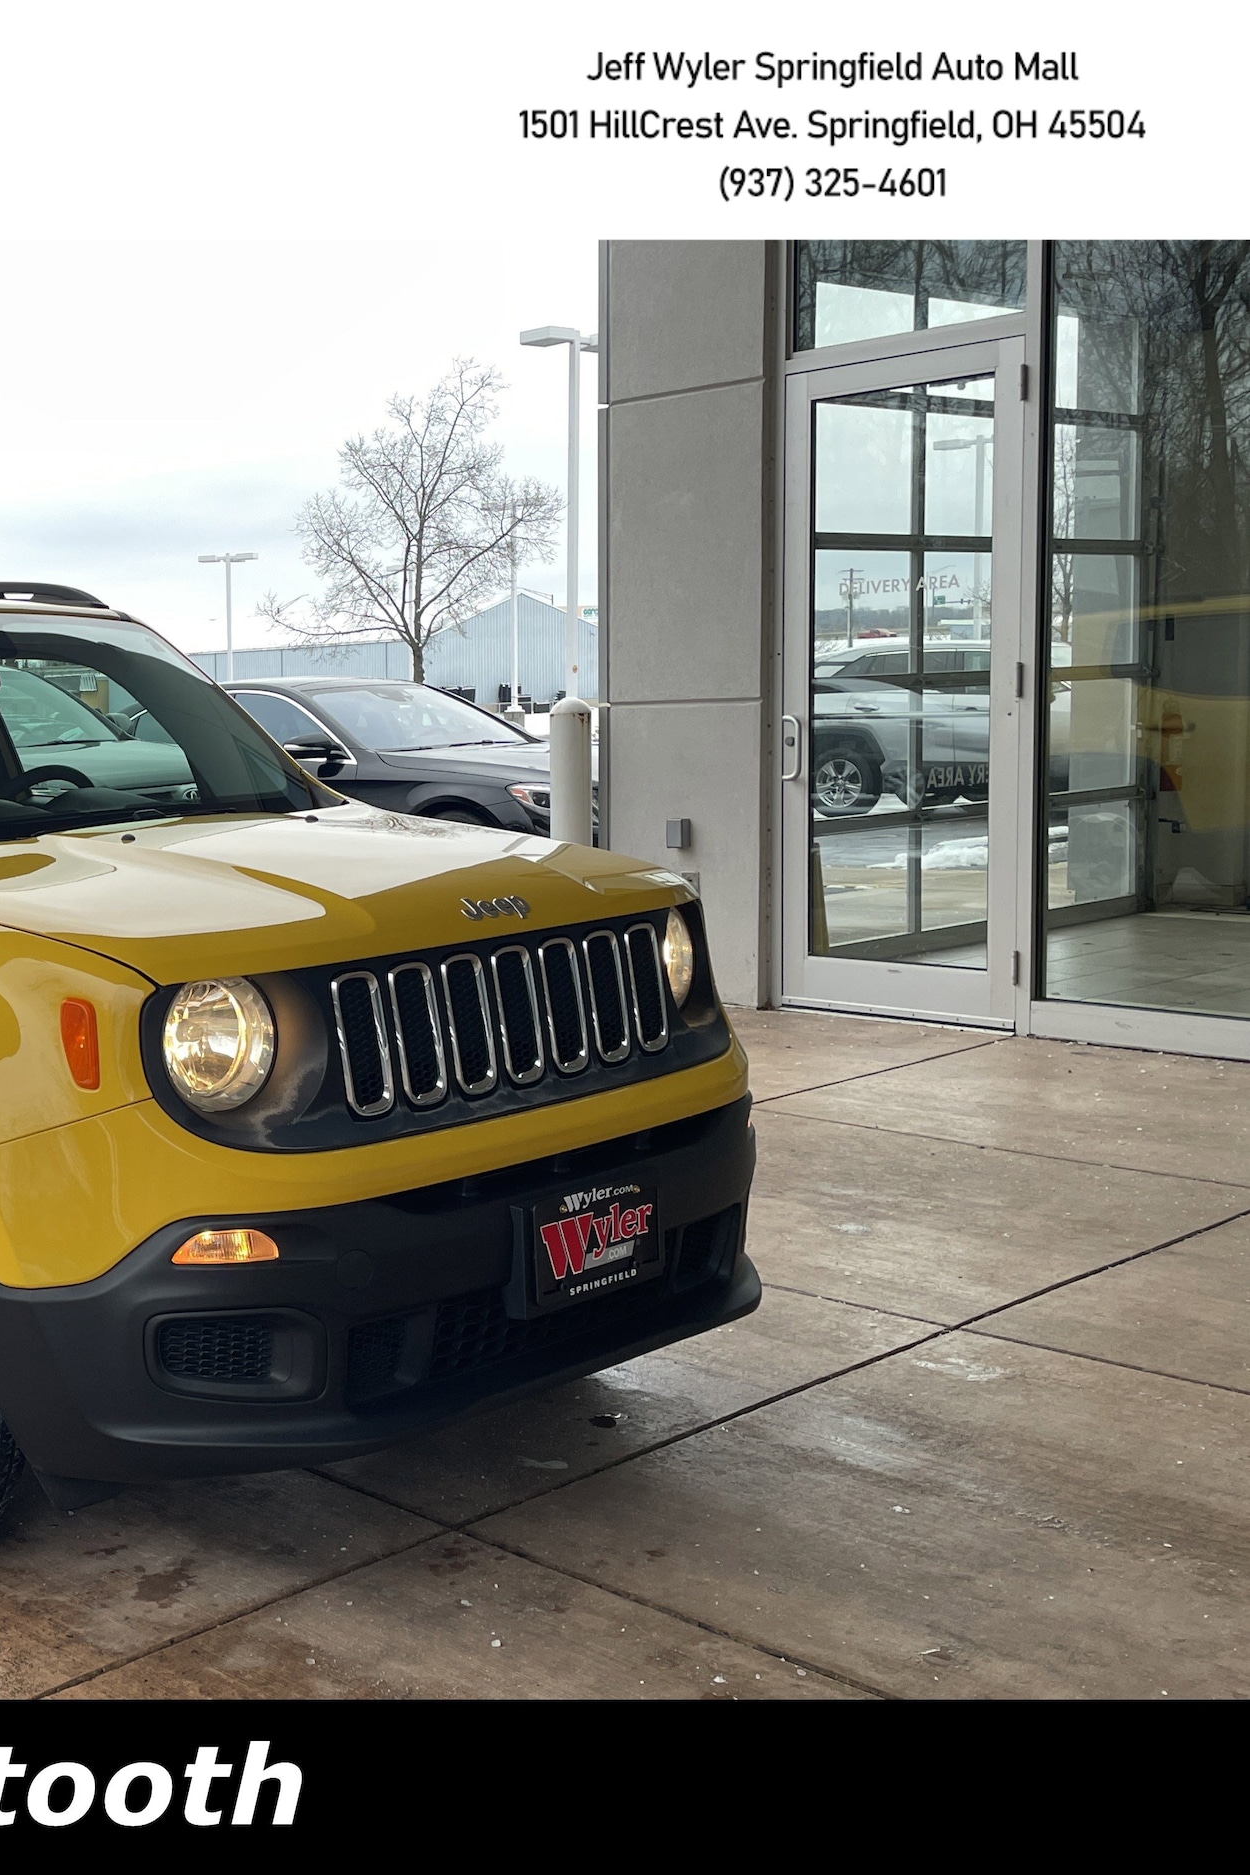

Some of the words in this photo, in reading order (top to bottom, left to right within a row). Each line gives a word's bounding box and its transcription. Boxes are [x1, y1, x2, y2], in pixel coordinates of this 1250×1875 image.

[839, 578, 910, 596] DELIVERY
[915, 575, 960, 592] AREA
[460, 895, 531, 921] Jeep
[540, 1202, 653, 1280] Wyler
[569, 1268, 637, 1296] SPRINGFIELD
